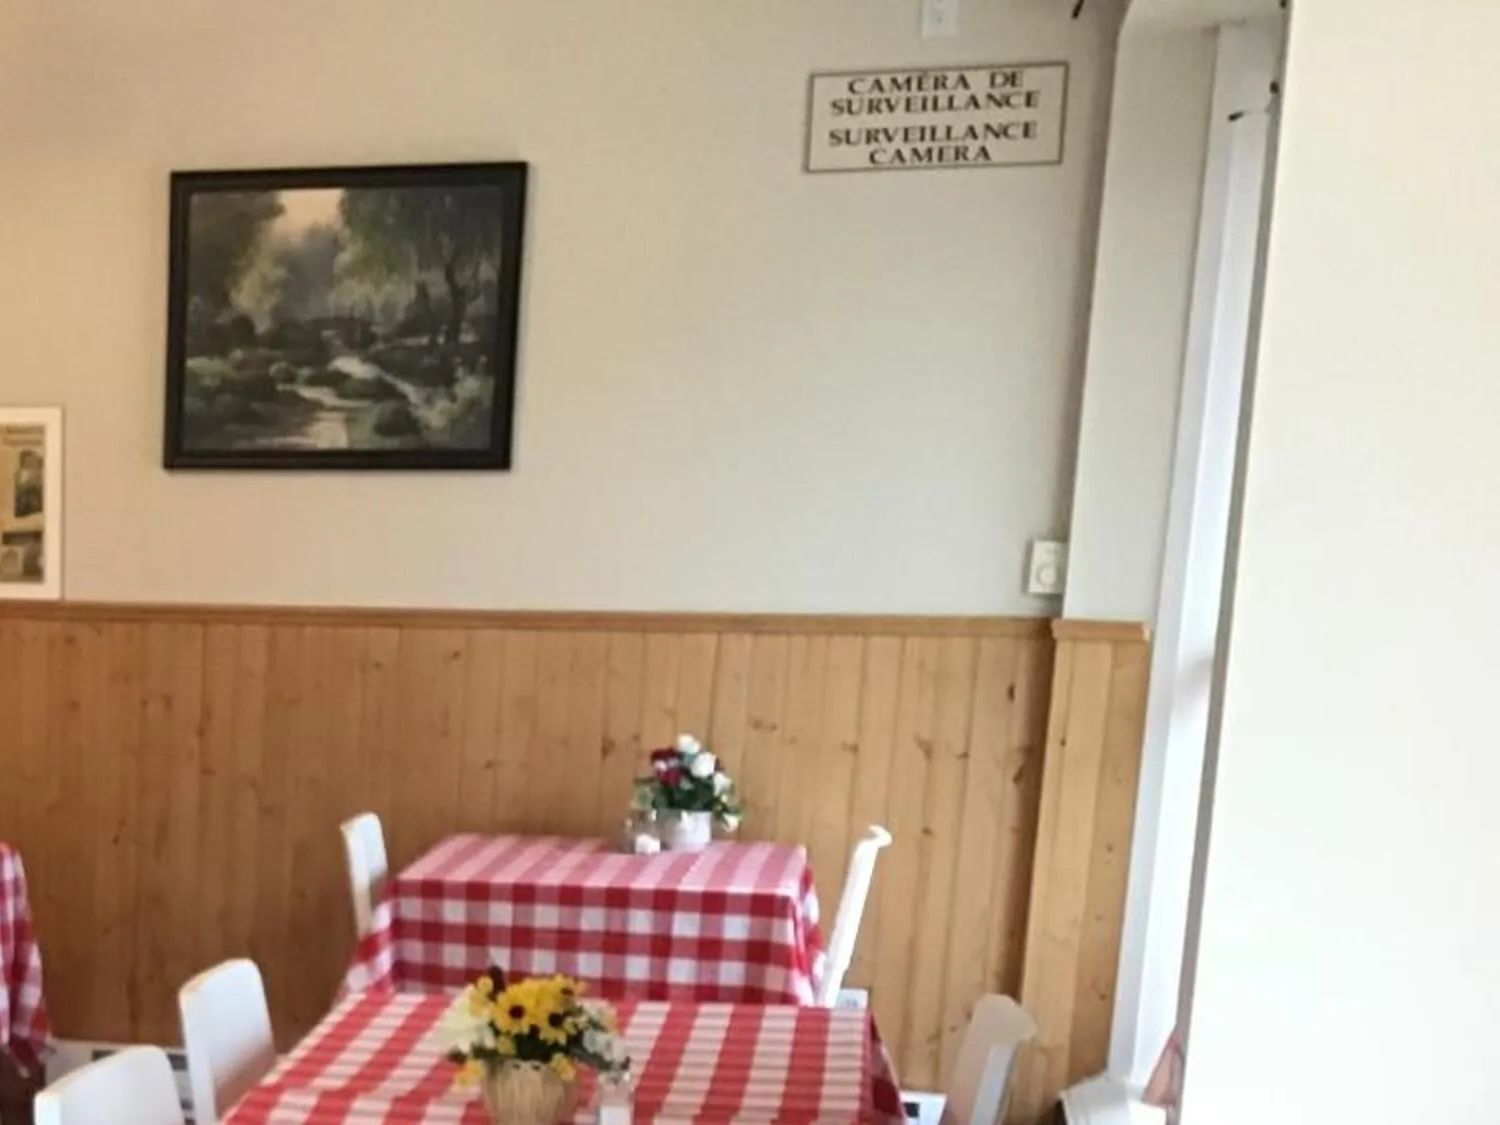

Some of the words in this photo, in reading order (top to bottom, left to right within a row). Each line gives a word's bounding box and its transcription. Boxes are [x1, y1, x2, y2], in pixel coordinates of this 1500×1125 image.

[989, 70, 1023, 89] DE
[830, 90, 1040, 116] SURVEILLANCE
[828, 121, 1038, 147] SURVEILLANCE
[868, 145, 992, 165] CAMERA
